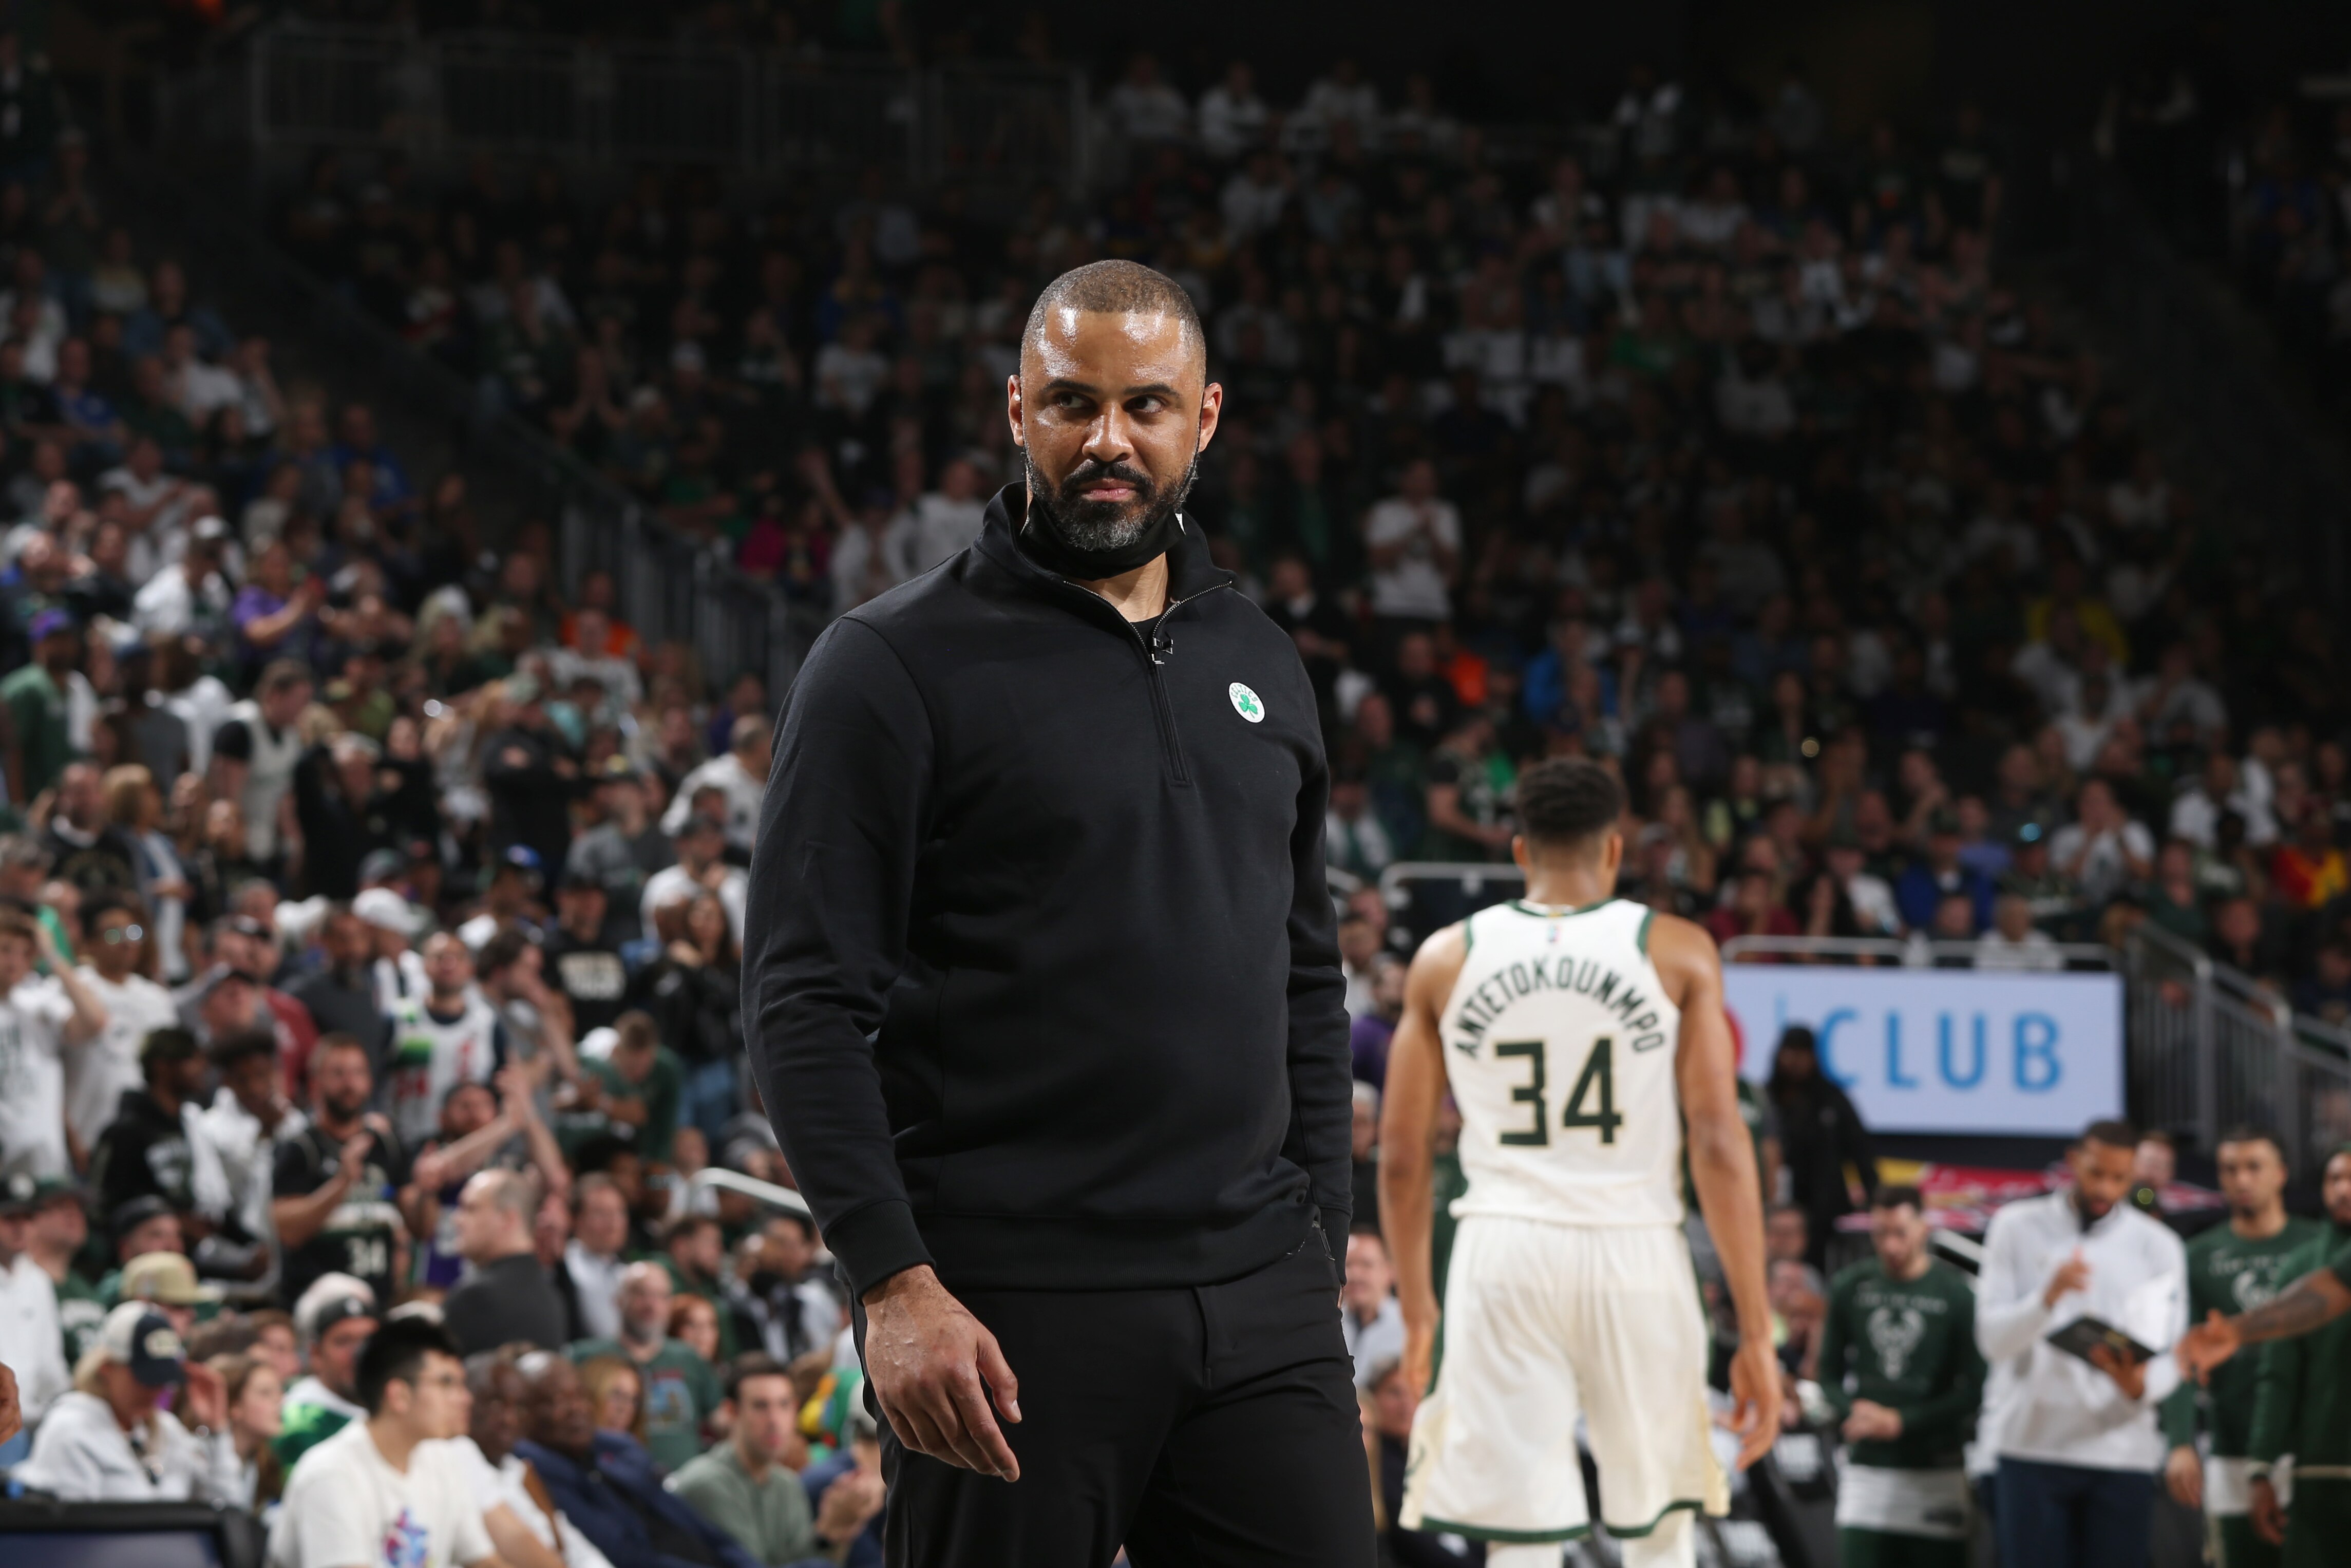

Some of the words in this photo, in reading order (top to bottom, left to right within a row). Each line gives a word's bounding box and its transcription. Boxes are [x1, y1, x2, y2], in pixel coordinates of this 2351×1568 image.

[1231, 684, 1258, 702] CELTICS
[1454, 955, 1665, 1058] ANTETOKOUNMPO
[1817, 1008, 2063, 1092] CLUB
[1495, 1036, 1623, 1147] 34
